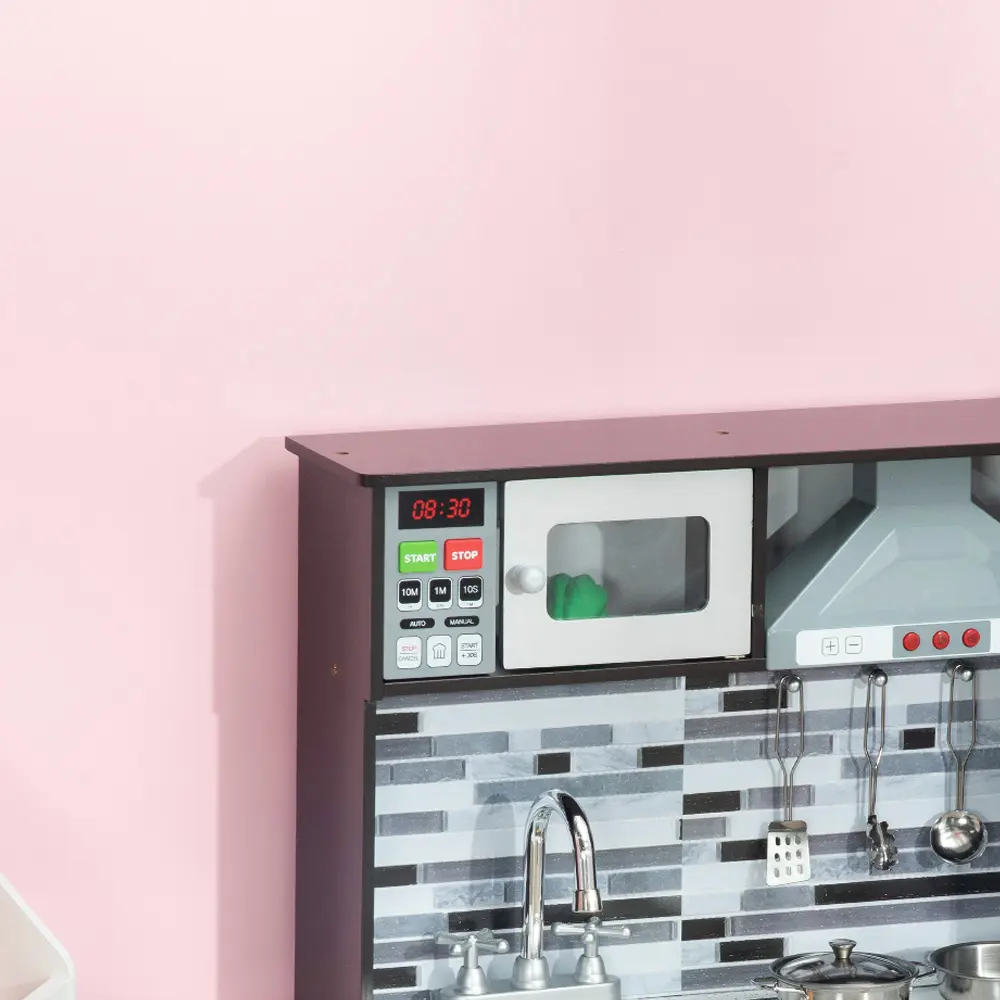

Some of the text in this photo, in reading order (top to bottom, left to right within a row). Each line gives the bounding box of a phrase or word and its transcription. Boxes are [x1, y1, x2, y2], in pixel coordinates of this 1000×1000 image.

[412, 498, 471, 520] 08:30
[404, 553, 436, 563] START
[452, 551, 478, 560] STOP
[401, 588, 418, 596] 10M
[434, 586, 447, 595] 1M
[463, 585, 478, 594] 10S
